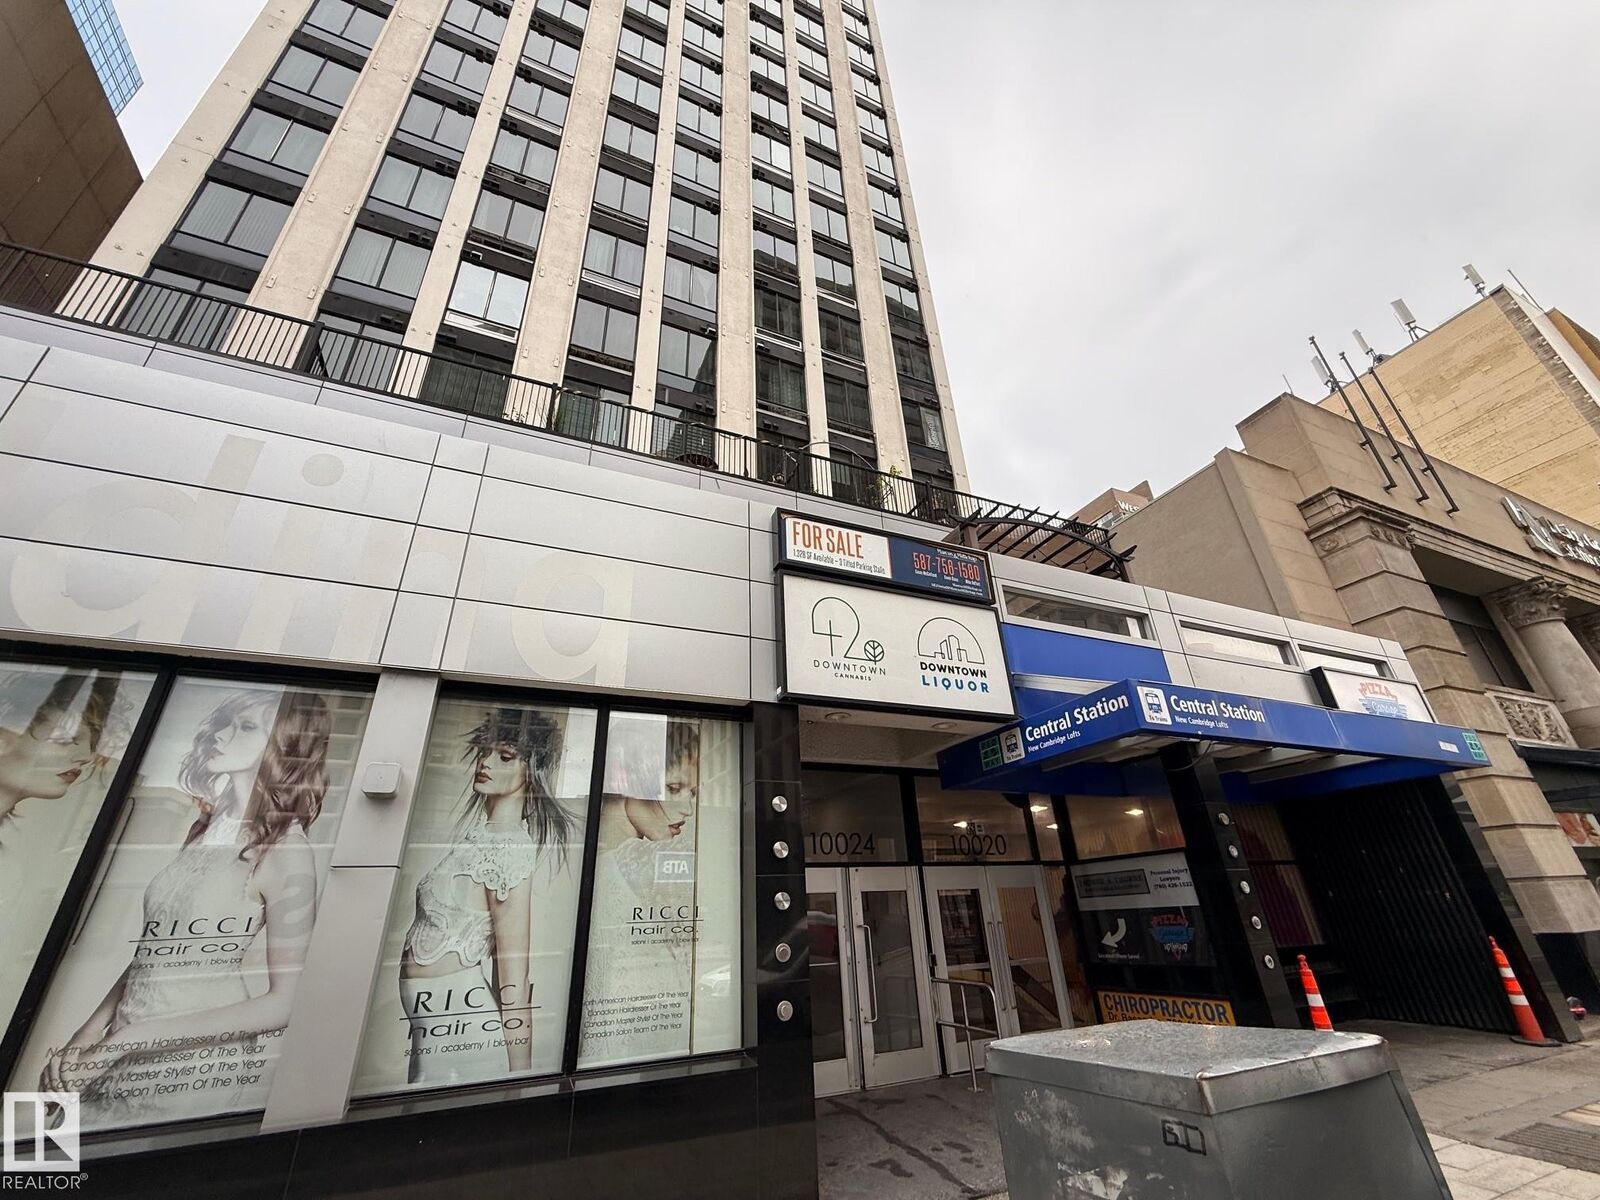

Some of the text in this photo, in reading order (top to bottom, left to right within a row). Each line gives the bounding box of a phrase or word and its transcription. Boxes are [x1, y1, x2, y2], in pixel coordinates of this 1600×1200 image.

[792, 520, 864, 559] FOR SALE
[813, 553, 834, 565] Available
[856, 561, 873, 573] Parking
[873, 565, 885, 575] Stalls
[813, 659, 886, 676] DOWNTOWN
[834, 672, 872, 681] CANNABIS
[920, 661, 987, 678] DOWNTOWN
[922, 674, 989, 693] LIQUOR
[1360, 682, 1397, 697] PIZZA
[1025, 694, 1129, 742] Central Station
[1170, 695, 1266, 723] Central Station
[1175, 715, 1229, 729] New Cambridge Lofts
[1028, 730, 1081, 753] New Cambridge Lofts
[810, 832, 875, 855] 10024
[950, 834, 1006, 856] 10020
[633, 906, 698, 920] RICCI
[141, 917, 253, 938] RICCI
[631, 925, 698, 935] hair co.
[134, 942, 245, 957] hair co.
[163, 960, 202, 968] academy
[210, 958, 230, 966] blow
[413, 983, 534, 1014] RICCI
[599, 997, 627, 1005] American
[587, 1008, 618, 1017] Canadian
[1103, 994, 1230, 1023] CHIROPRACTOR
[1108, 1011, 1119, 1021] Dr.
[407, 1018, 530, 1040] hair co.
[584, 1020, 614, 1028] Canadian
[584, 1031, 614, 1039] Canadian
[616, 1028, 632, 1036] Salon
[45, 1047, 82, 1058] North
[219, 1031, 235, 1042] Of
[238, 1030, 257, 1040] The
[260, 1028, 287, 1039] Year
[441, 1041, 484, 1053] academy
[493, 1039, 513, 1048] blow
[515, 1037, 530, 1045] bar
[128, 1051, 196, 1066] Hairdresser
[199, 1049, 214, 1060] Of
[217, 1047, 238, 1057] The
[241, 1044, 266, 1055] Year
[118, 1070, 162, 1082] Master
[163, 1065, 196, 1080] Stylist
[199, 1063, 215, 1074] Of
[218, 1061, 238, 1072] The
[242, 1058, 267, 1069] Year
[113, 1087, 149, 1100] Salon
[154, 1082, 189, 1095] Team
[193, 1079, 209, 1090] Of
[211, 1076, 232, 1088] The
[236, 1074, 261, 1085] Year
